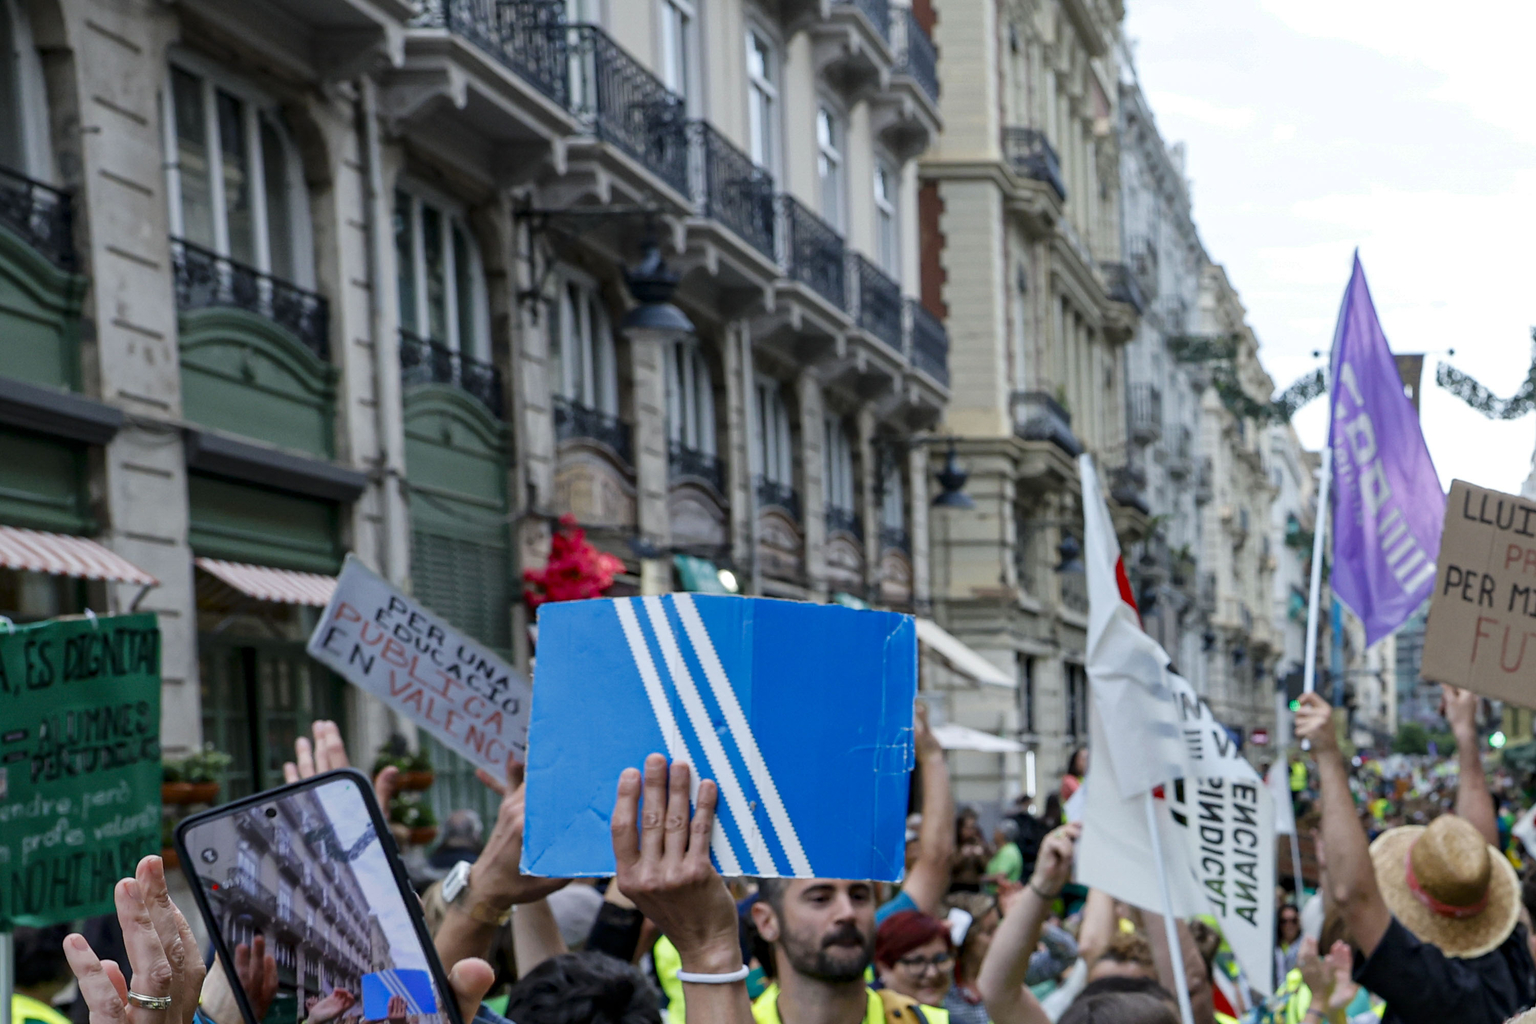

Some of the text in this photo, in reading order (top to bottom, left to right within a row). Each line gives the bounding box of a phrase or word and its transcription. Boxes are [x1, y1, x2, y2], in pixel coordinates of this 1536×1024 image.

[1442, 564, 1497, 608] PER
[388, 595, 510, 693] PER UNA
